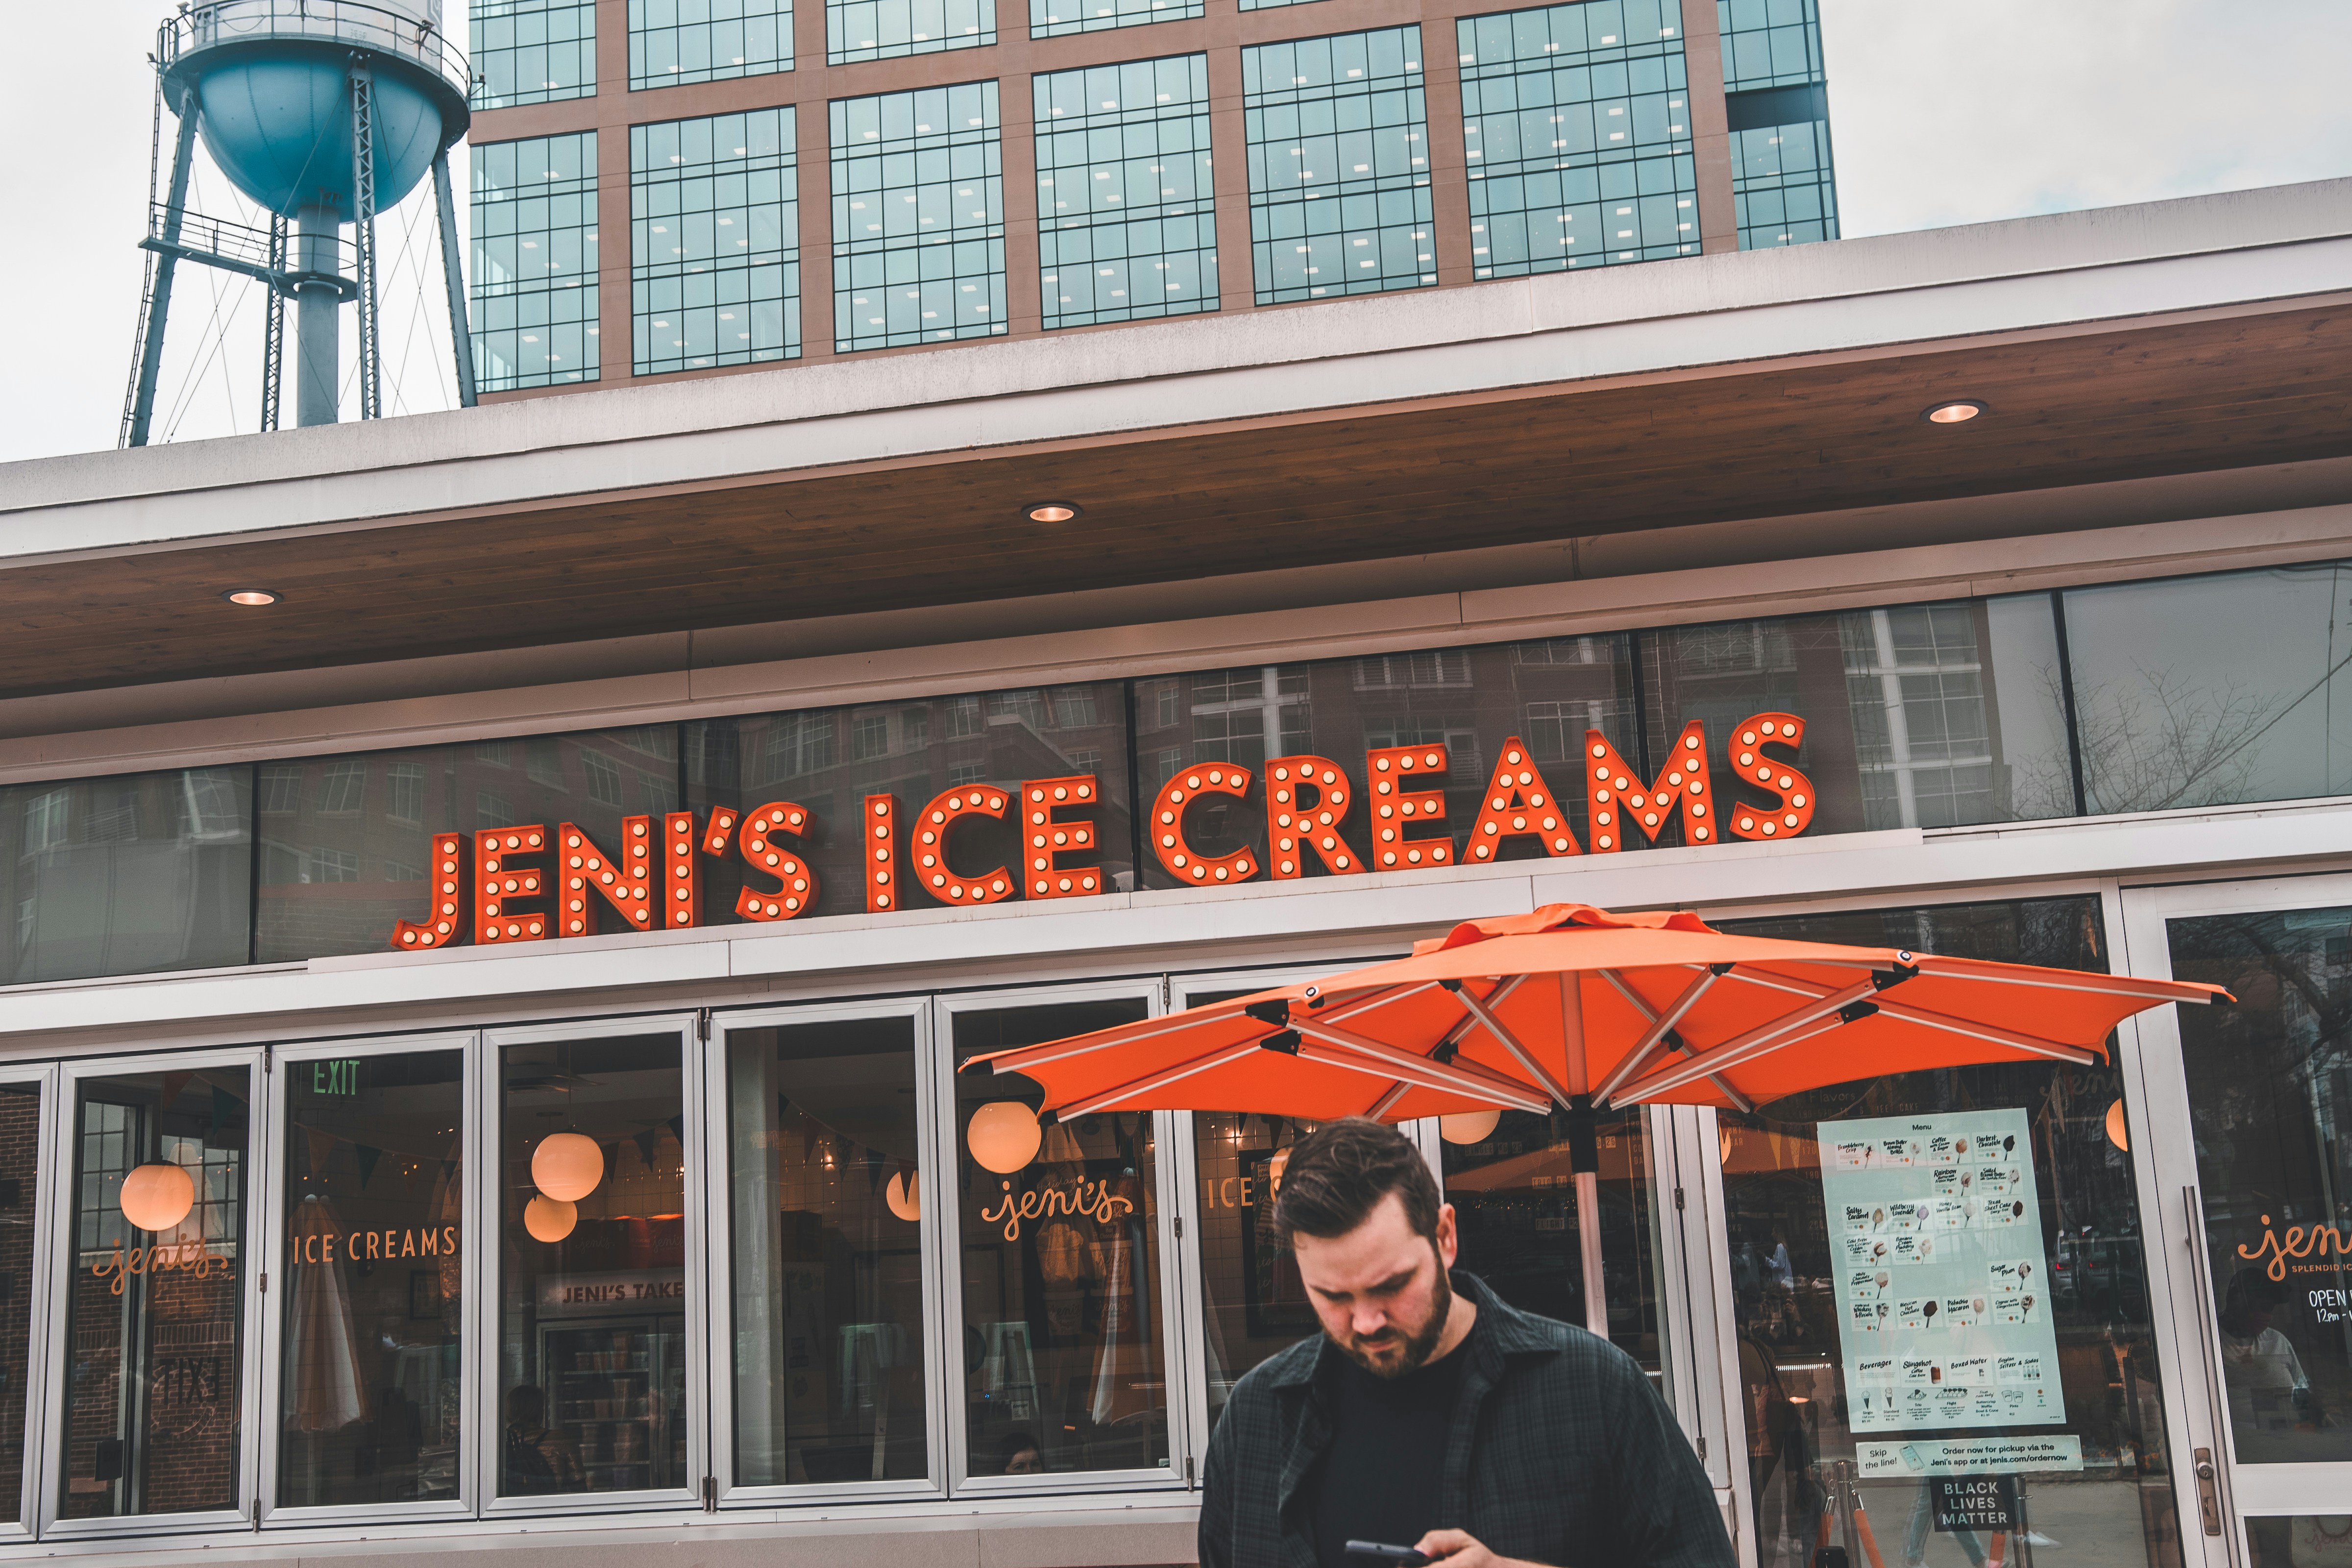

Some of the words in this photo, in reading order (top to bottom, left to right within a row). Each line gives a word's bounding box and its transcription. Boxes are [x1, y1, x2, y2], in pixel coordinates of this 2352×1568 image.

[391, 802, 817, 952] JENI'S
[864, 774, 1103, 914] ICE
[1151, 712, 1815, 887] CREAMS
[314, 1060, 360, 1095] EXIT
[1809, 1089, 1855, 1103] Flavors
[1976, 1134, 1997, 1143] Darkest
[1978, 1139, 2001, 1148] Chocolate
[1838, 1142, 1864, 1151] Brambleberry
[1934, 1169, 1957, 1177] Rainbow
[1532, 1177, 1551, 1187] TRIO
[1208, 1177, 1253, 1208] ICE
[981, 1175, 1133, 1241] jeni's
[1846, 1206, 1862, 1215] Salty
[1889, 1203, 1914, 1212] Wildberry
[1892, 1208, 1915, 1217] Lavender
[1848, 1211, 1869, 1221] Caramel
[1536, 1219, 1564, 1229] FLIGHT
[294, 1234, 334, 1264] ICE
[348, 1226, 455, 1260] CREAMS
[575, 1235, 615, 1254] jeni's
[2238, 1215, 2352, 1281] jen
[92, 1233, 227, 1295] jeni's
[1990, 1264, 2007, 1273] Sugar
[2292, 1264, 2340, 1273] SPLENDID
[2001, 1268, 2015, 1277] Plum
[563, 1284, 626, 1303] JENI'S
[633, 1281, 683, 1299] TAKE
[2309, 1289, 2347, 1307] OPEN
[1900, 1308, 1920, 1317] Chocolate
[1947, 1304, 1969, 1314] Macaron
[2316, 1308, 2339, 1323] 12pm
[1860, 1360, 1892, 1371] Beverages
[1903, 1359, 1933, 1369] Slingshot
[1951, 1359, 1969, 1369] Boxed
[1870, 1448, 1886, 1458] Skip
[1999, 1445, 2025, 1455] pickup
[1865, 1461, 1879, 1470] the
[1881, 1457, 1897, 1468] line!
[1931, 1458, 1952, 1467] Jeni's
[1990, 1453, 2067, 1466] jenis.com/ordernow
[1944, 1481, 1999, 1494] BLACK
[1951, 1497, 1996, 1510] LIVES
[1942, 1512, 2008, 1525] MATTER
